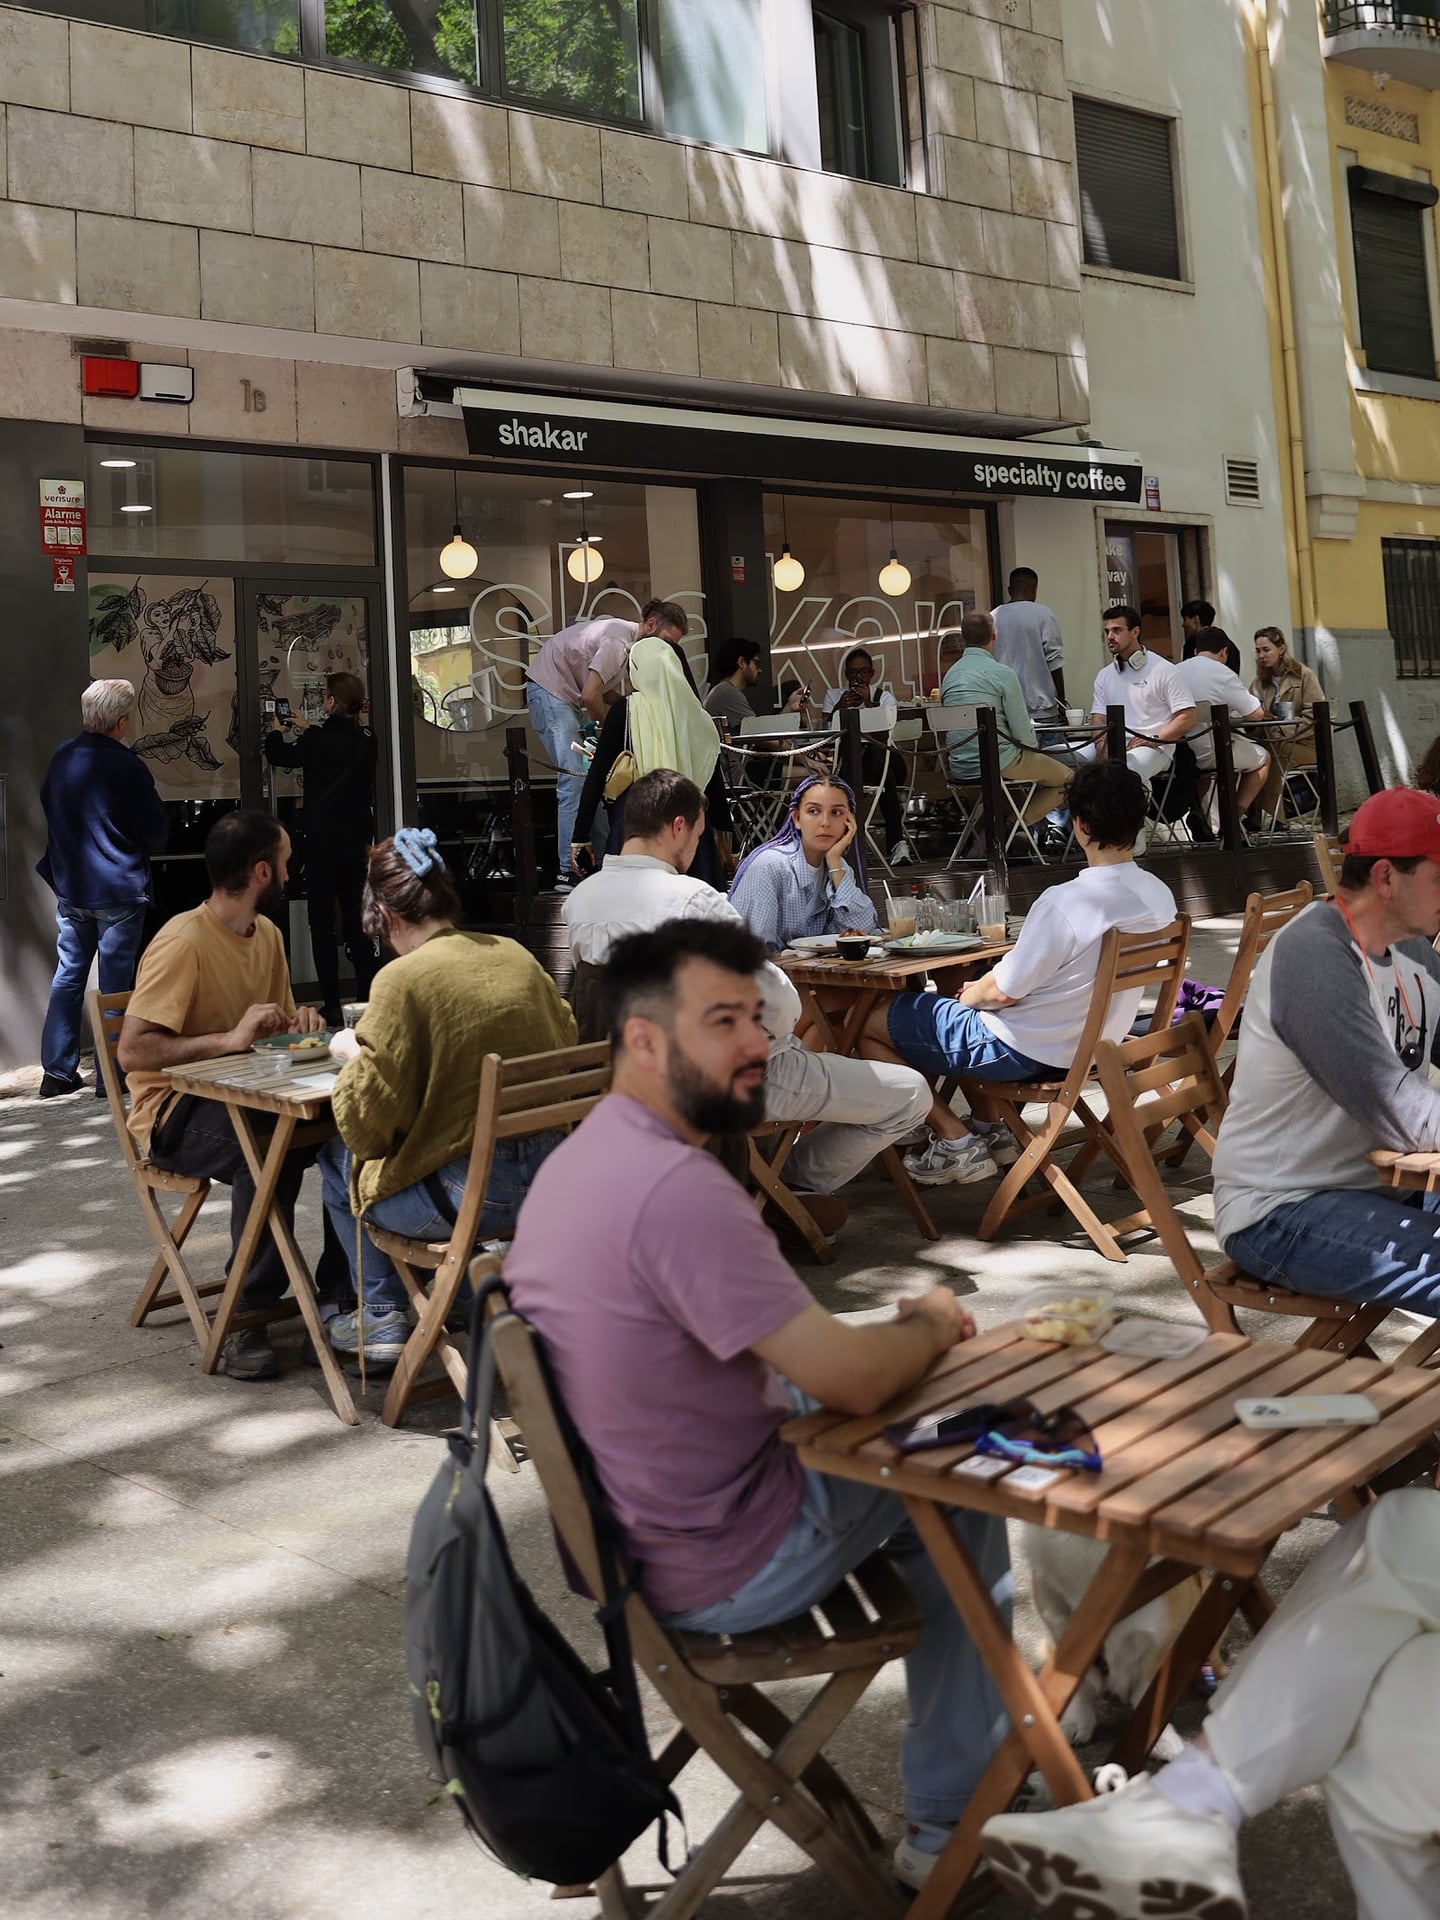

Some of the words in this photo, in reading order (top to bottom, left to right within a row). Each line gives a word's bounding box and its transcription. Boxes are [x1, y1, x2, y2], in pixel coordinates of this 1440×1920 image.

[239, 378, 268, 413] 1B
[498, 417, 588, 452] shakar
[973, 461, 1062, 493] specialty
[1065, 467, 1127, 492] coffee
[44, 495, 81, 503] verisure
[45, 508, 81, 519] Alarme
